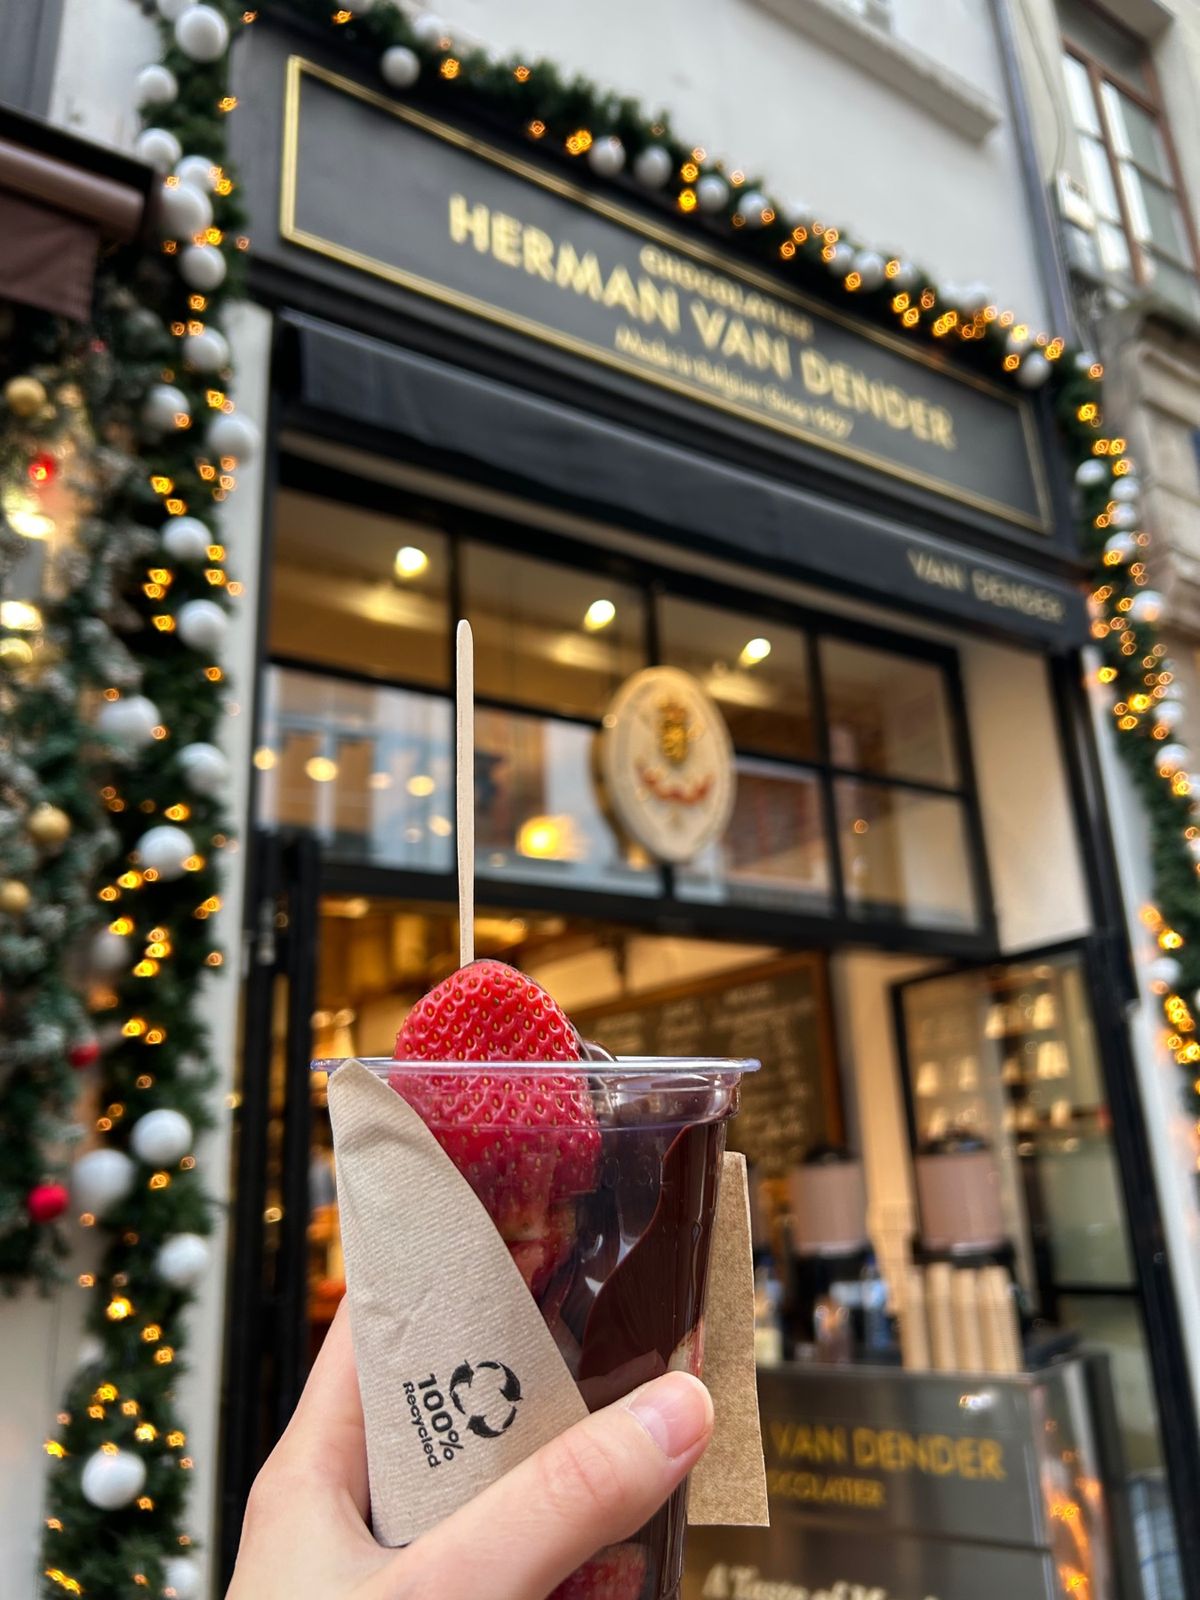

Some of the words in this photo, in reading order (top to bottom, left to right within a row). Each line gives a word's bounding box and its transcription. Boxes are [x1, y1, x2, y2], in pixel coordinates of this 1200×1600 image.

[449, 192, 681, 336] HERMAN
[689, 300, 793, 382] VAN
[800, 350, 955, 450] DENDER
[906, 549, 968, 593] VAN
[970, 567, 1068, 624] DENDER
[402, 1381, 442, 1468] Recycled
[418, 1372, 465, 1461] 100%
[768, 1421, 847, 1466] VAN
[852, 1426, 1008, 1483] DENDER
